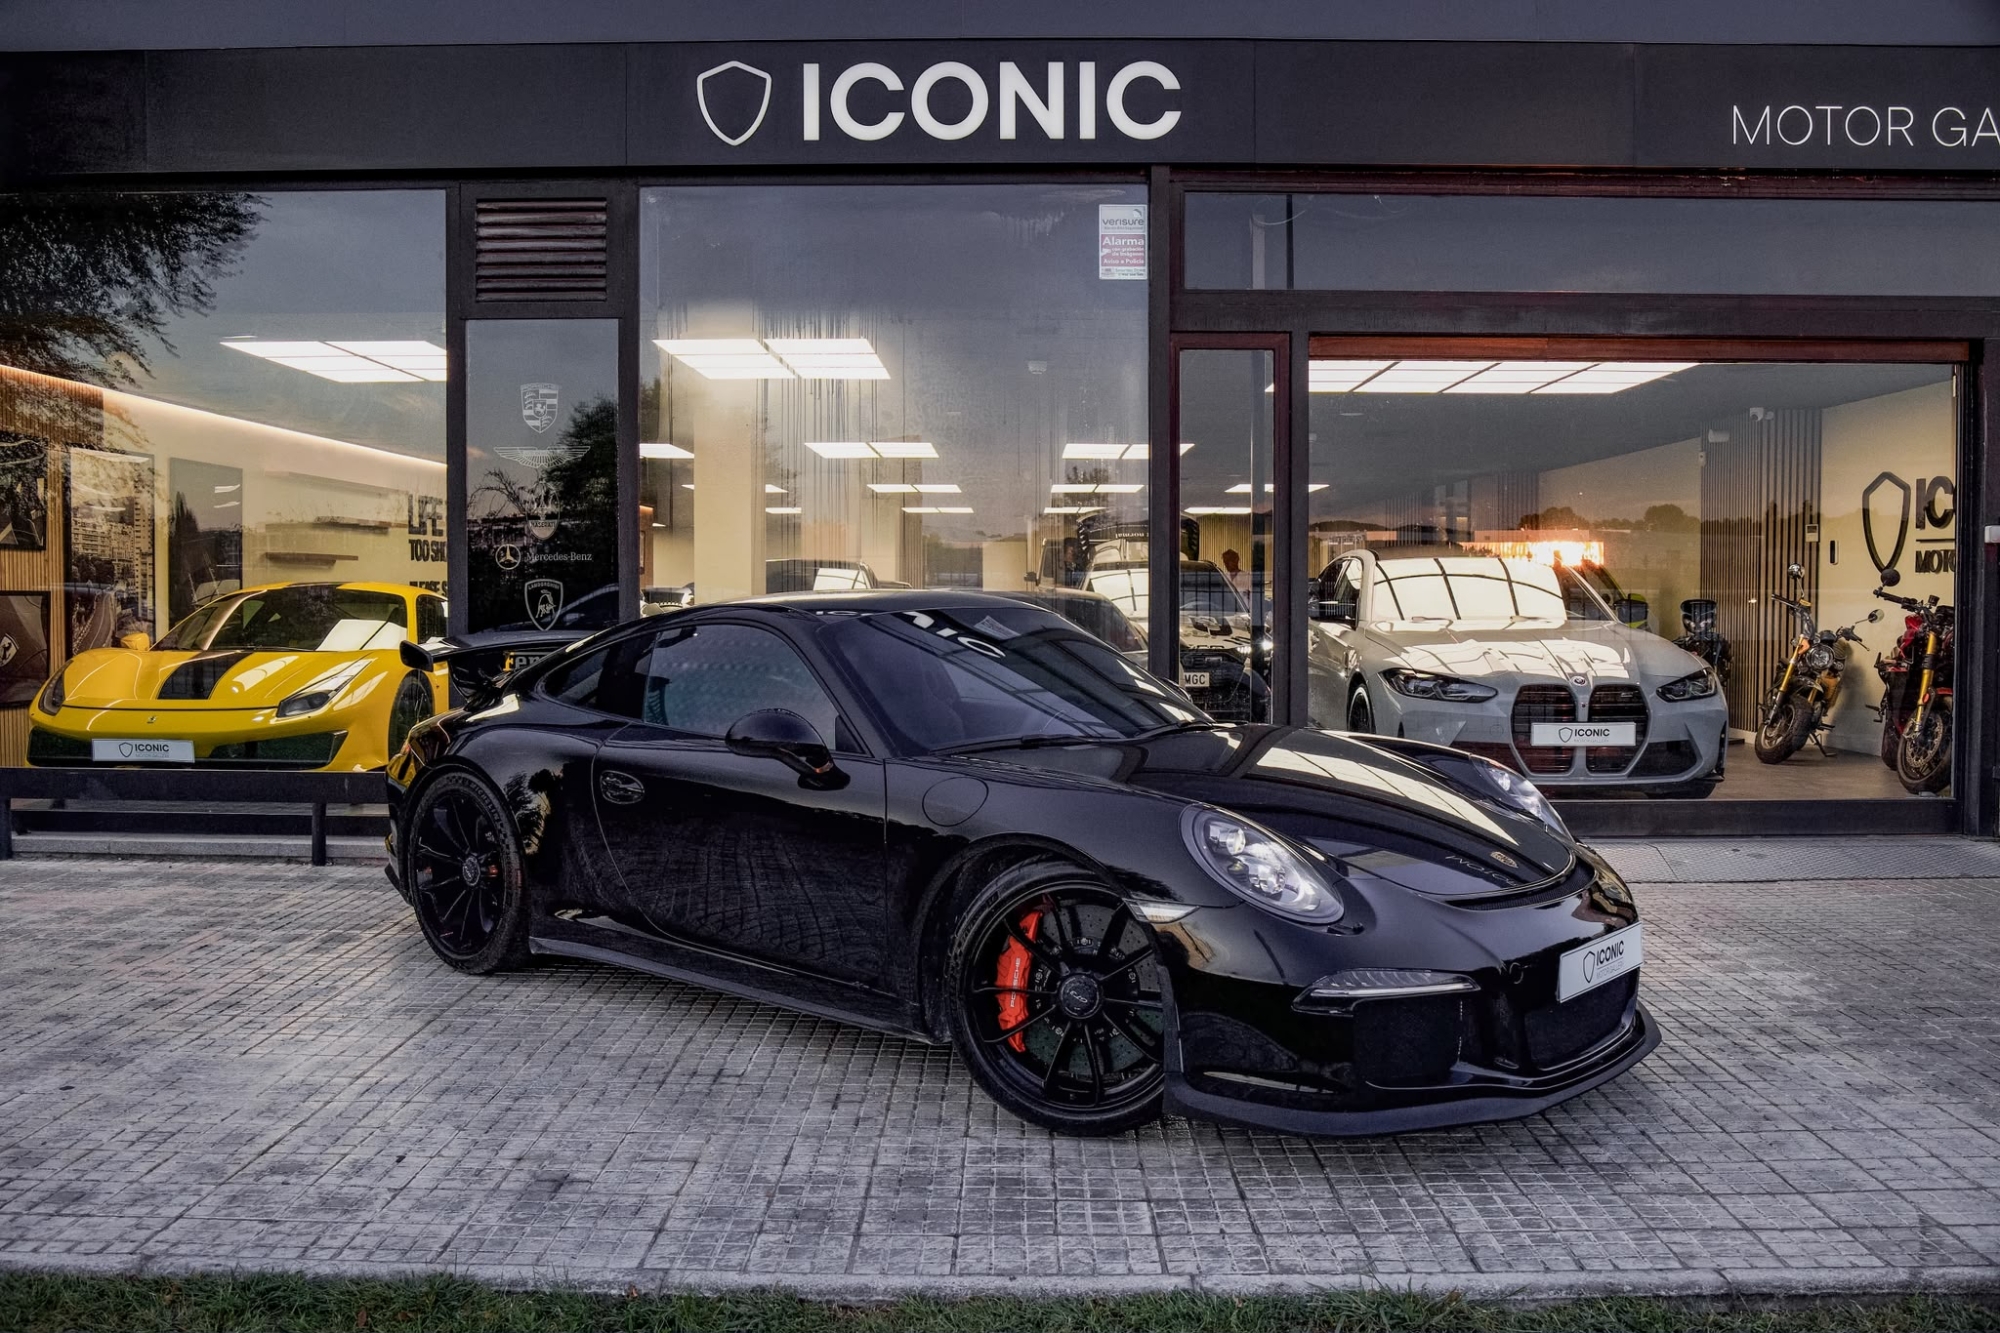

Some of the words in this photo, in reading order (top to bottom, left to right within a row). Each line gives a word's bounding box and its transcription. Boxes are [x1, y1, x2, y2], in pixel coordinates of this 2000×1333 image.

[803, 61, 1182, 141] ICONIC
[1732, 105, 1914, 146] MOTOR
[1931, 106, 2000, 147] GA
[1102, 218, 1145, 226] verisure
[1102, 236, 1145, 246] Alarma
[1916, 476, 1956, 529] IC
[408, 495, 443, 537] LIFE
[408, 539, 430, 562] TOO
[526, 551, 593, 561] Mercedes-Benz
[1574, 728, 1610, 737] ICONIC
[134, 743, 170, 752] ICONIC
[1596, 940, 1625, 967] ICONIC
[1010, 957, 1021, 1008] POSCHE
